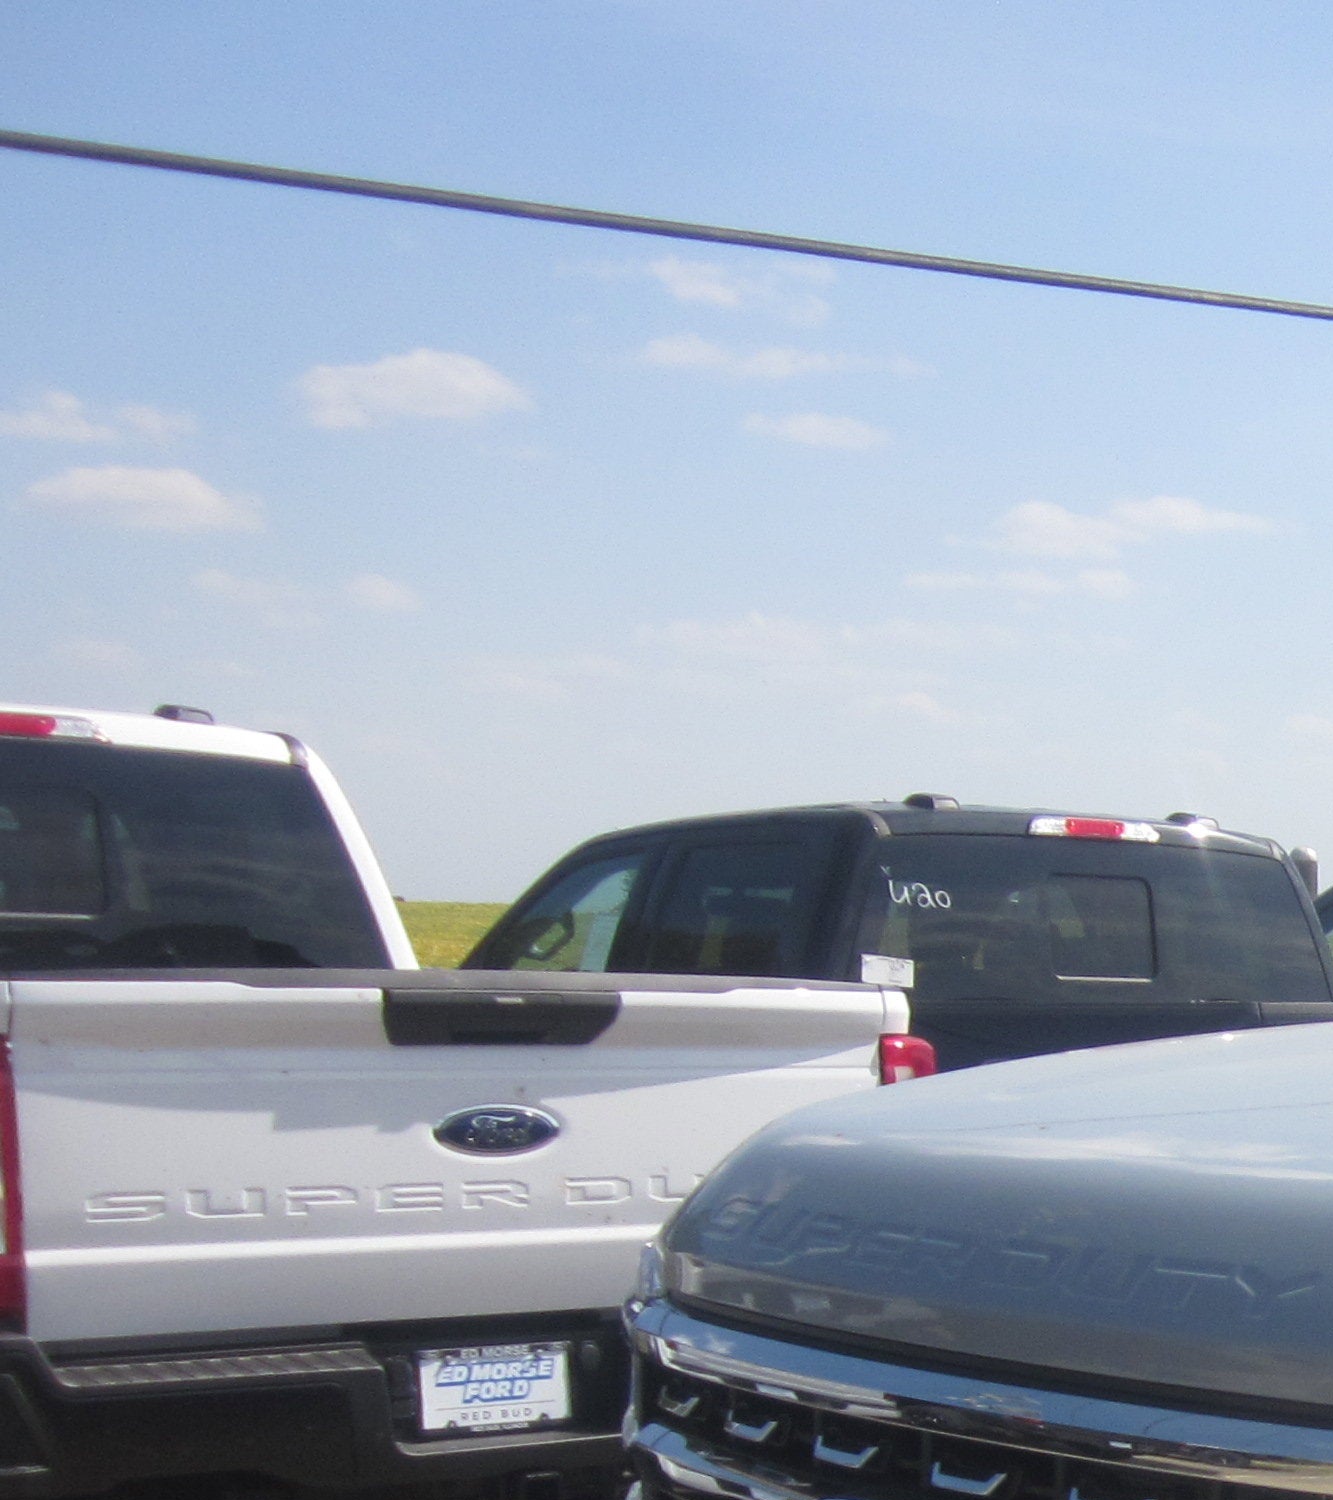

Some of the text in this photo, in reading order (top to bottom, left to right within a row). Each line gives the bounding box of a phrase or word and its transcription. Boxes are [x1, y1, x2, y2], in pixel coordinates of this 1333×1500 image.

[85, 1179, 530, 1224] SUPER
[702, 1198, 970, 1280] SUPER
[436, 1357, 555, 1387] ED MORSE
[463, 1379, 531, 1404] FORD
[459, 1407, 533, 1422] RED BUD
